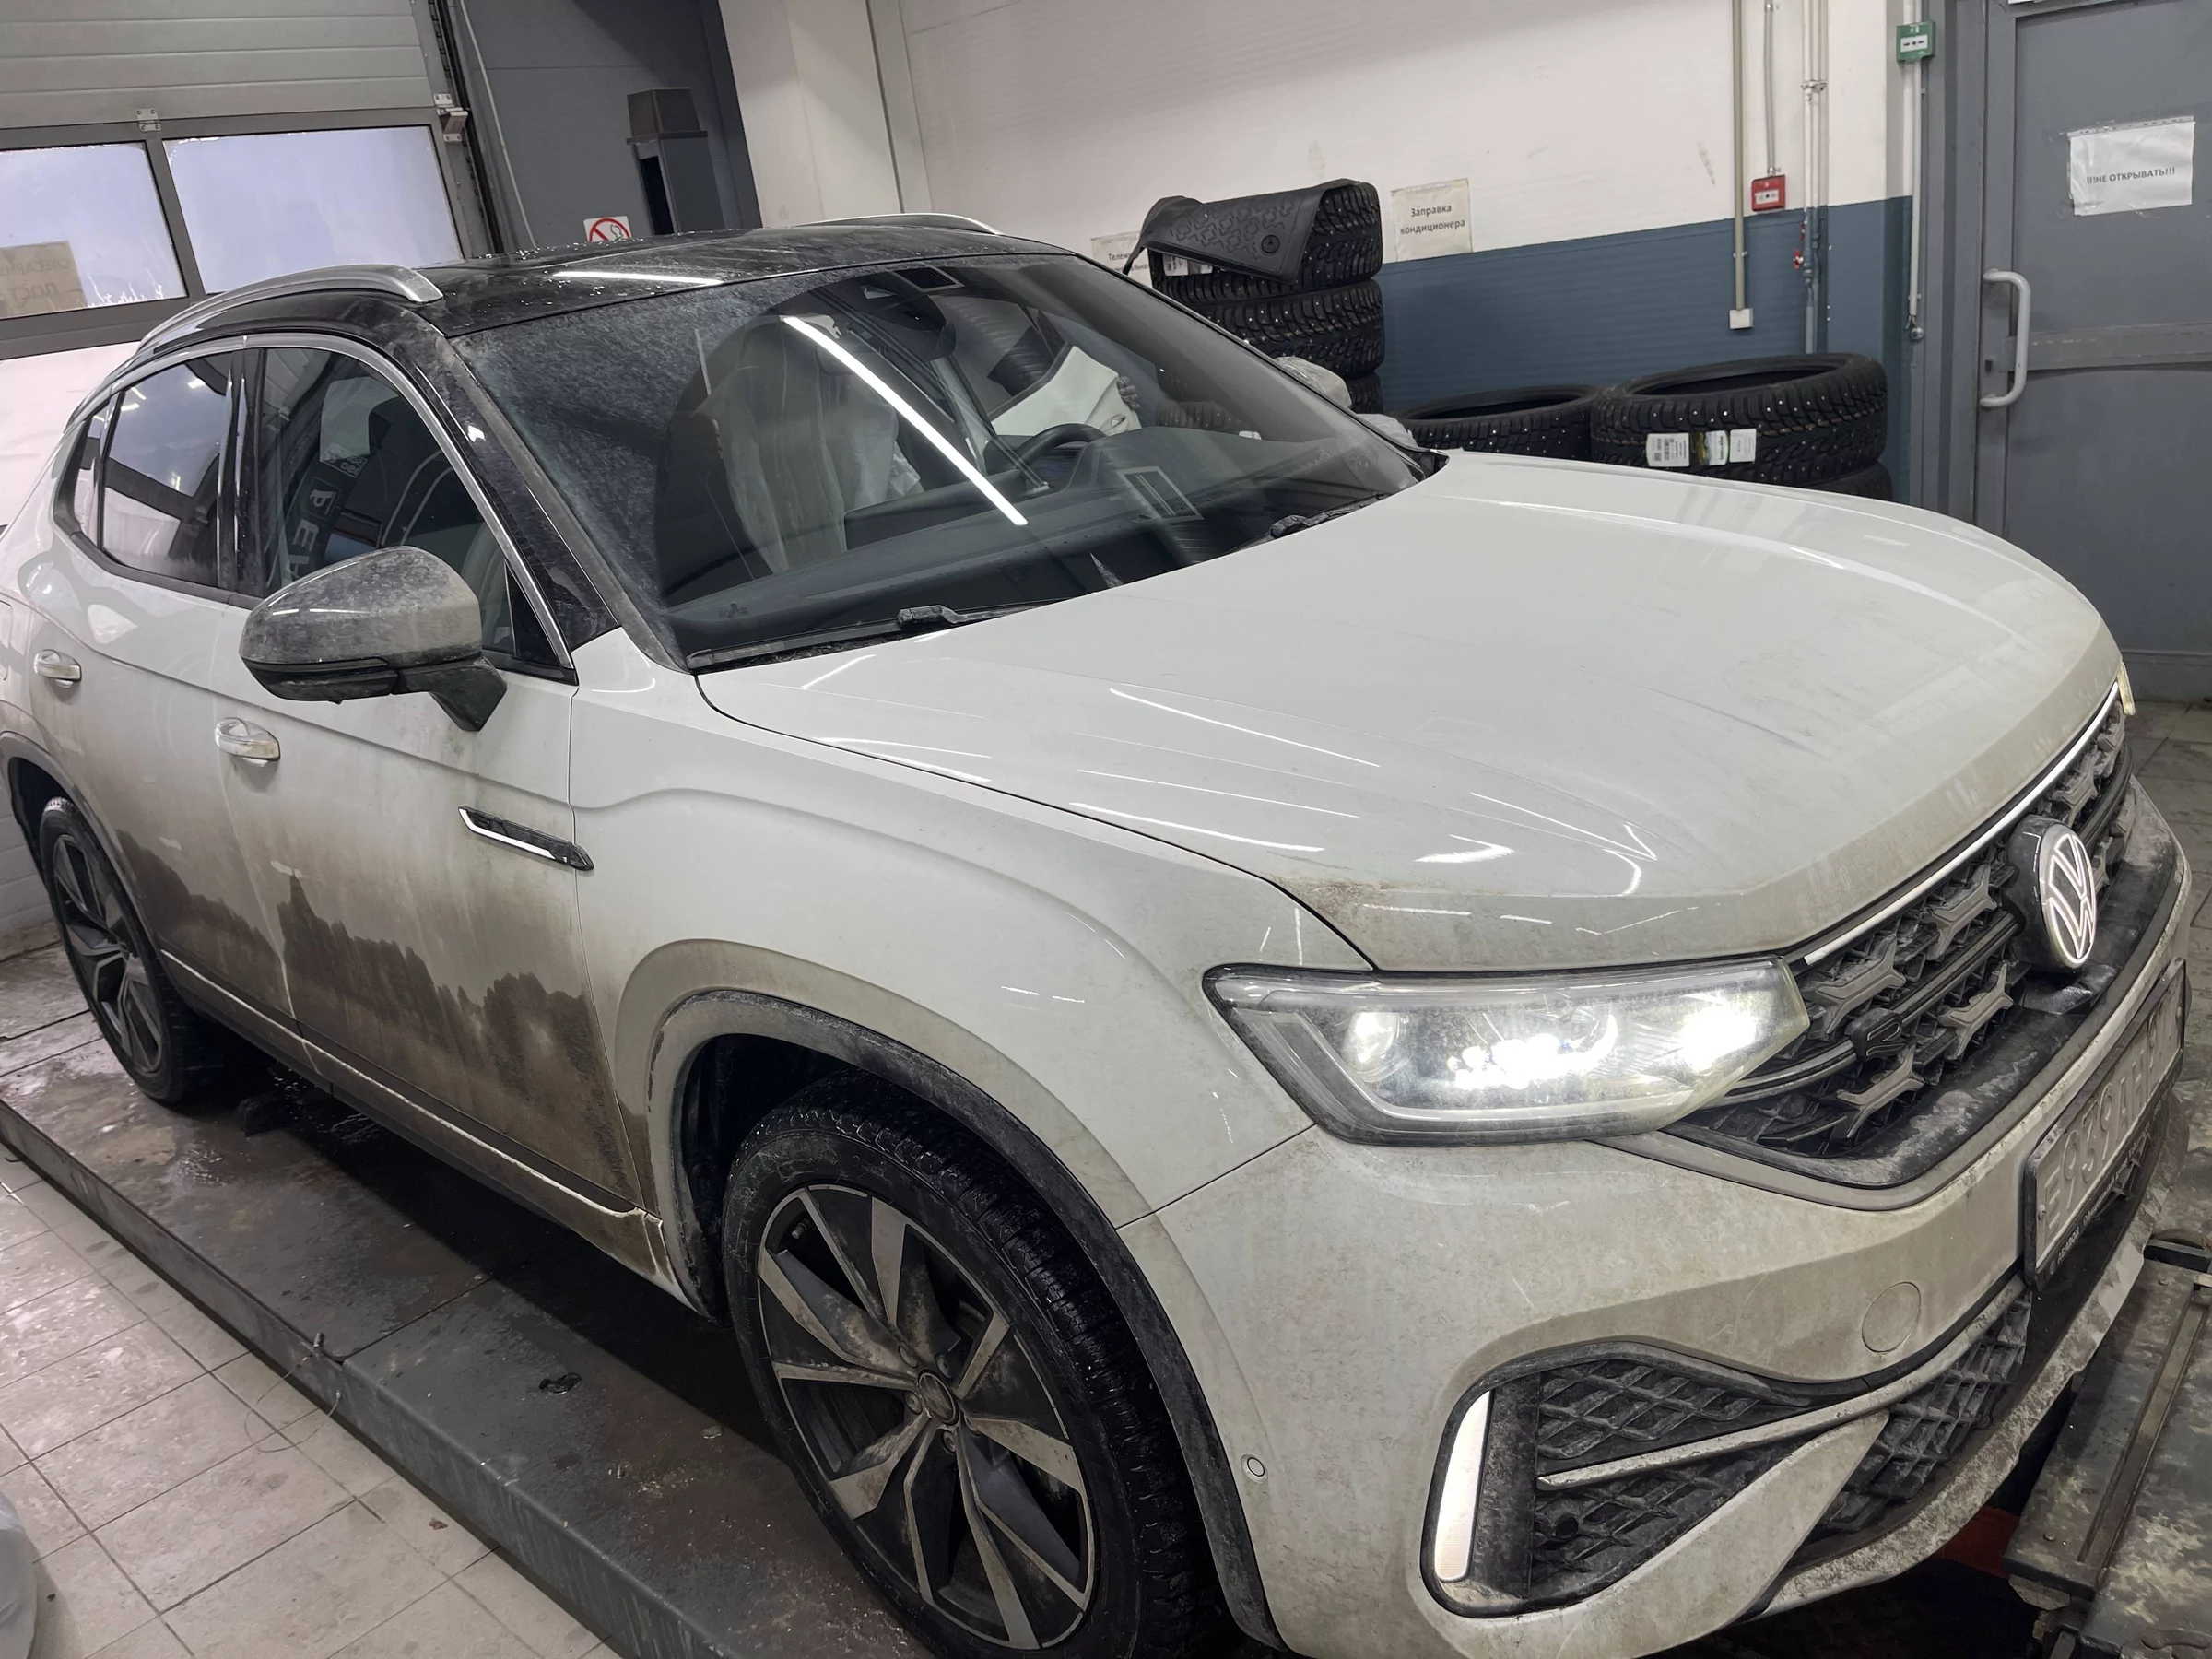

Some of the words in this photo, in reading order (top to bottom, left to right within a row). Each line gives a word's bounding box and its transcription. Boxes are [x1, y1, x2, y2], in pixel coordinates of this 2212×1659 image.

[2109, 167, 2175, 182] ОТКРЫВАТЬ!!!
[1410, 205, 1452, 218] Заправка
[1400, 219, 1465, 235] кондиционера
